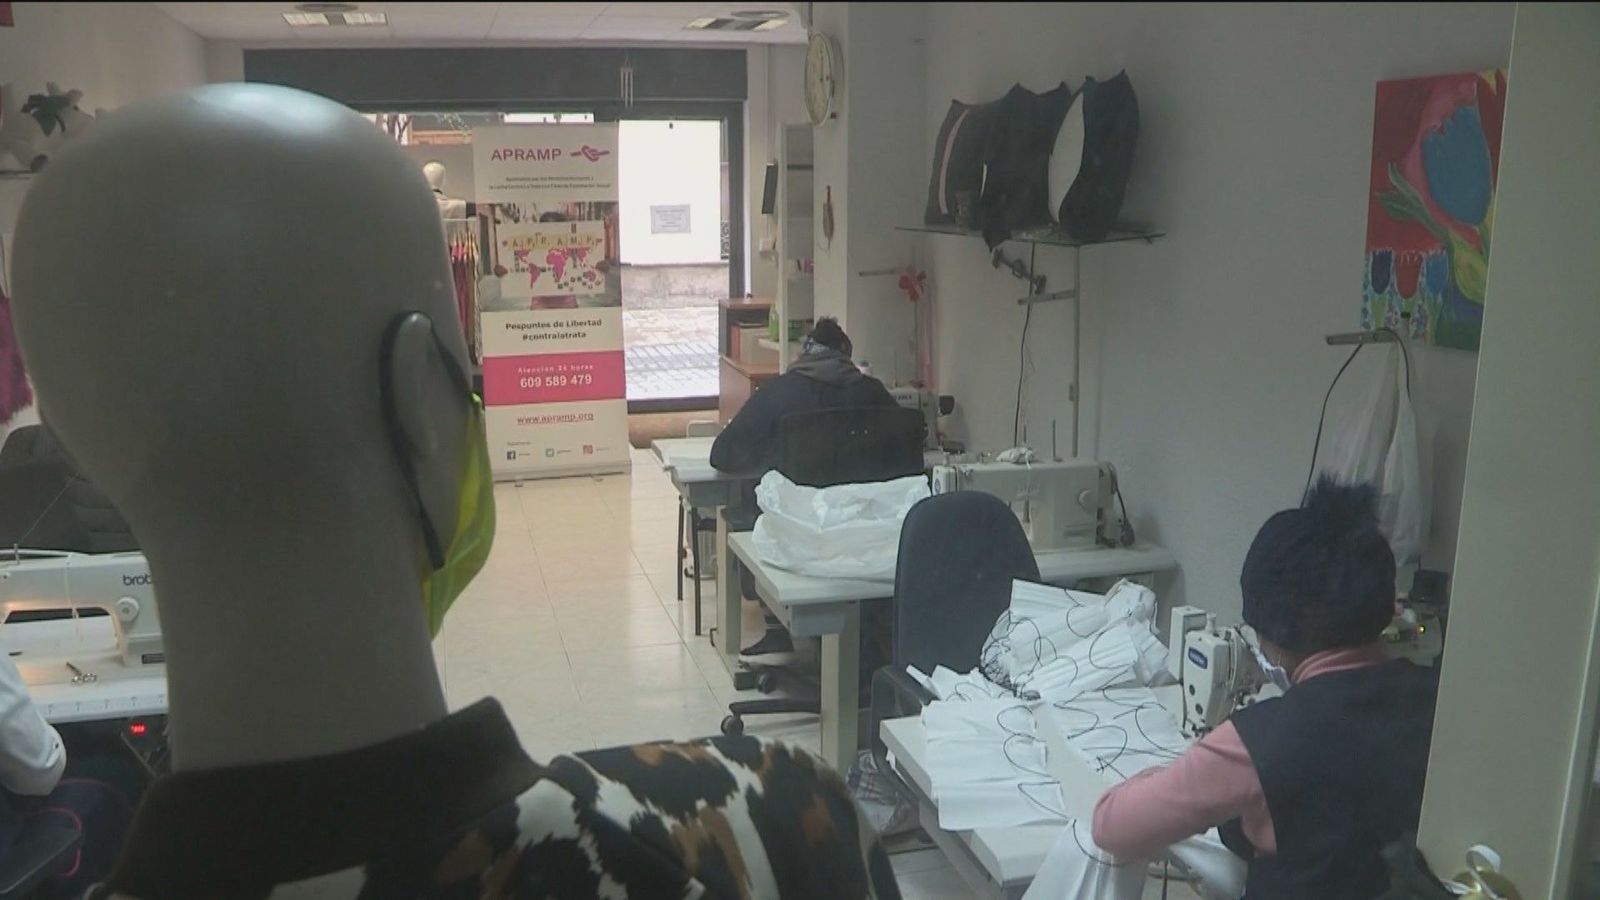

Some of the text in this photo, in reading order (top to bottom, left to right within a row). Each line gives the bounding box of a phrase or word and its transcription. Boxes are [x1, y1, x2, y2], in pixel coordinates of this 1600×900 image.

[491, 148, 562, 162] APRAMP
[505, 318, 602, 331] Pespuntes de Libertad
[522, 331, 587, 341] #contralatrata
[558, 364, 568, 372] 24
[571, 363, 594, 371] horas
[520, 373, 592, 388] 609 589 479
[517, 413, 594, 425] www.apramp.org
